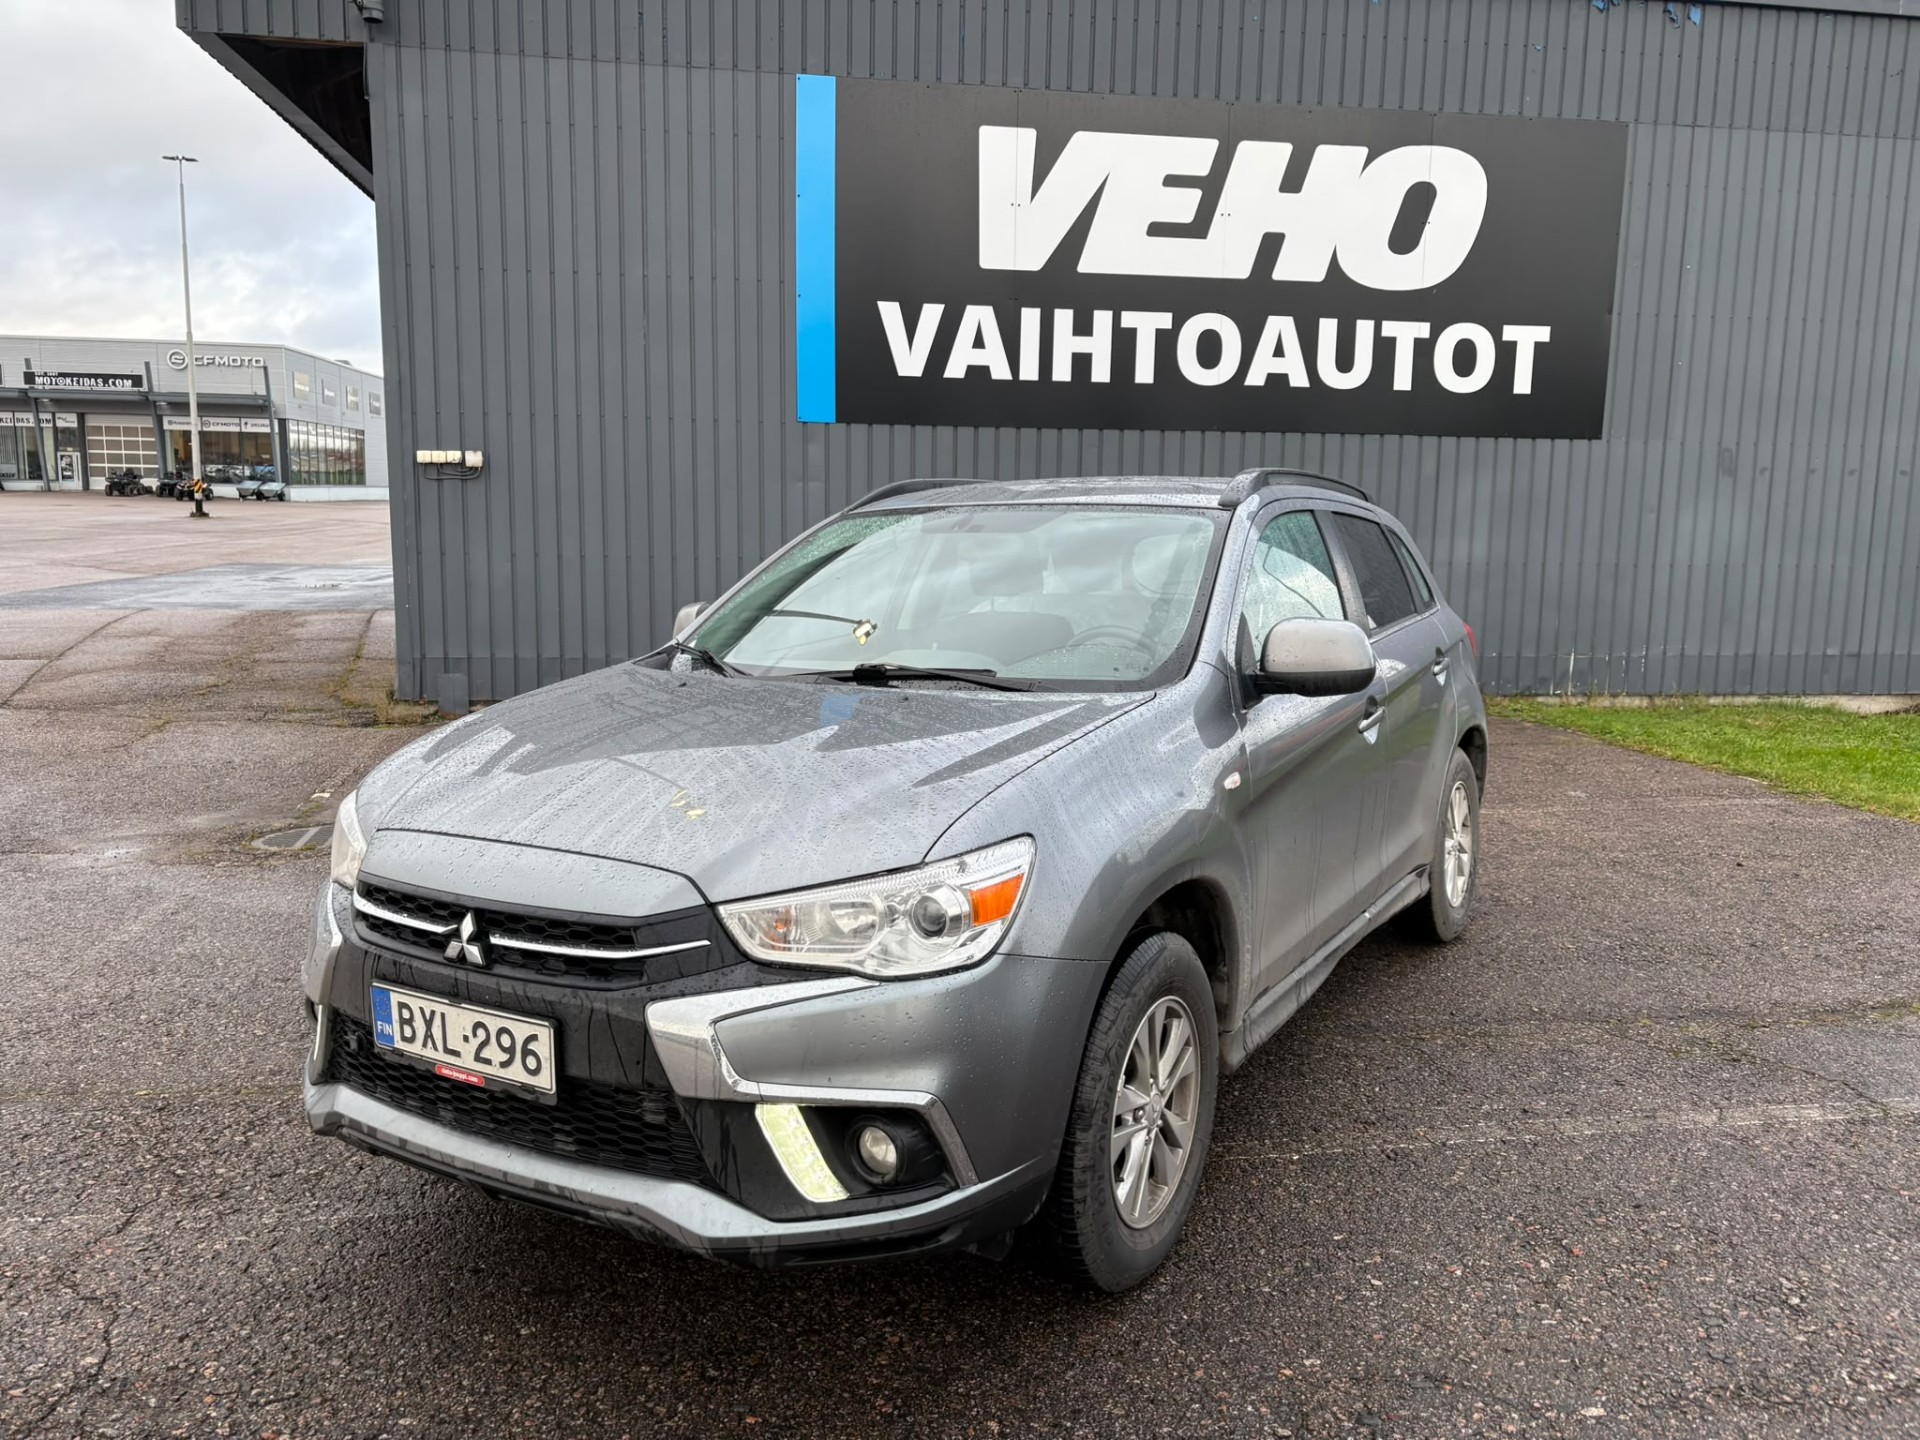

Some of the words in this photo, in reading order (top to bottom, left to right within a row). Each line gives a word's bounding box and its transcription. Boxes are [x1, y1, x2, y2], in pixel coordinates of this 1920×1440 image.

[978, 125, 1488, 291] VEHO
[193, 355, 264, 367] CFMOTO
[877, 300, 1551, 394] VAIHTOAUTOT
[377, 1021, 393, 1036] FIN
[397, 1001, 542, 1076] BXL-296
